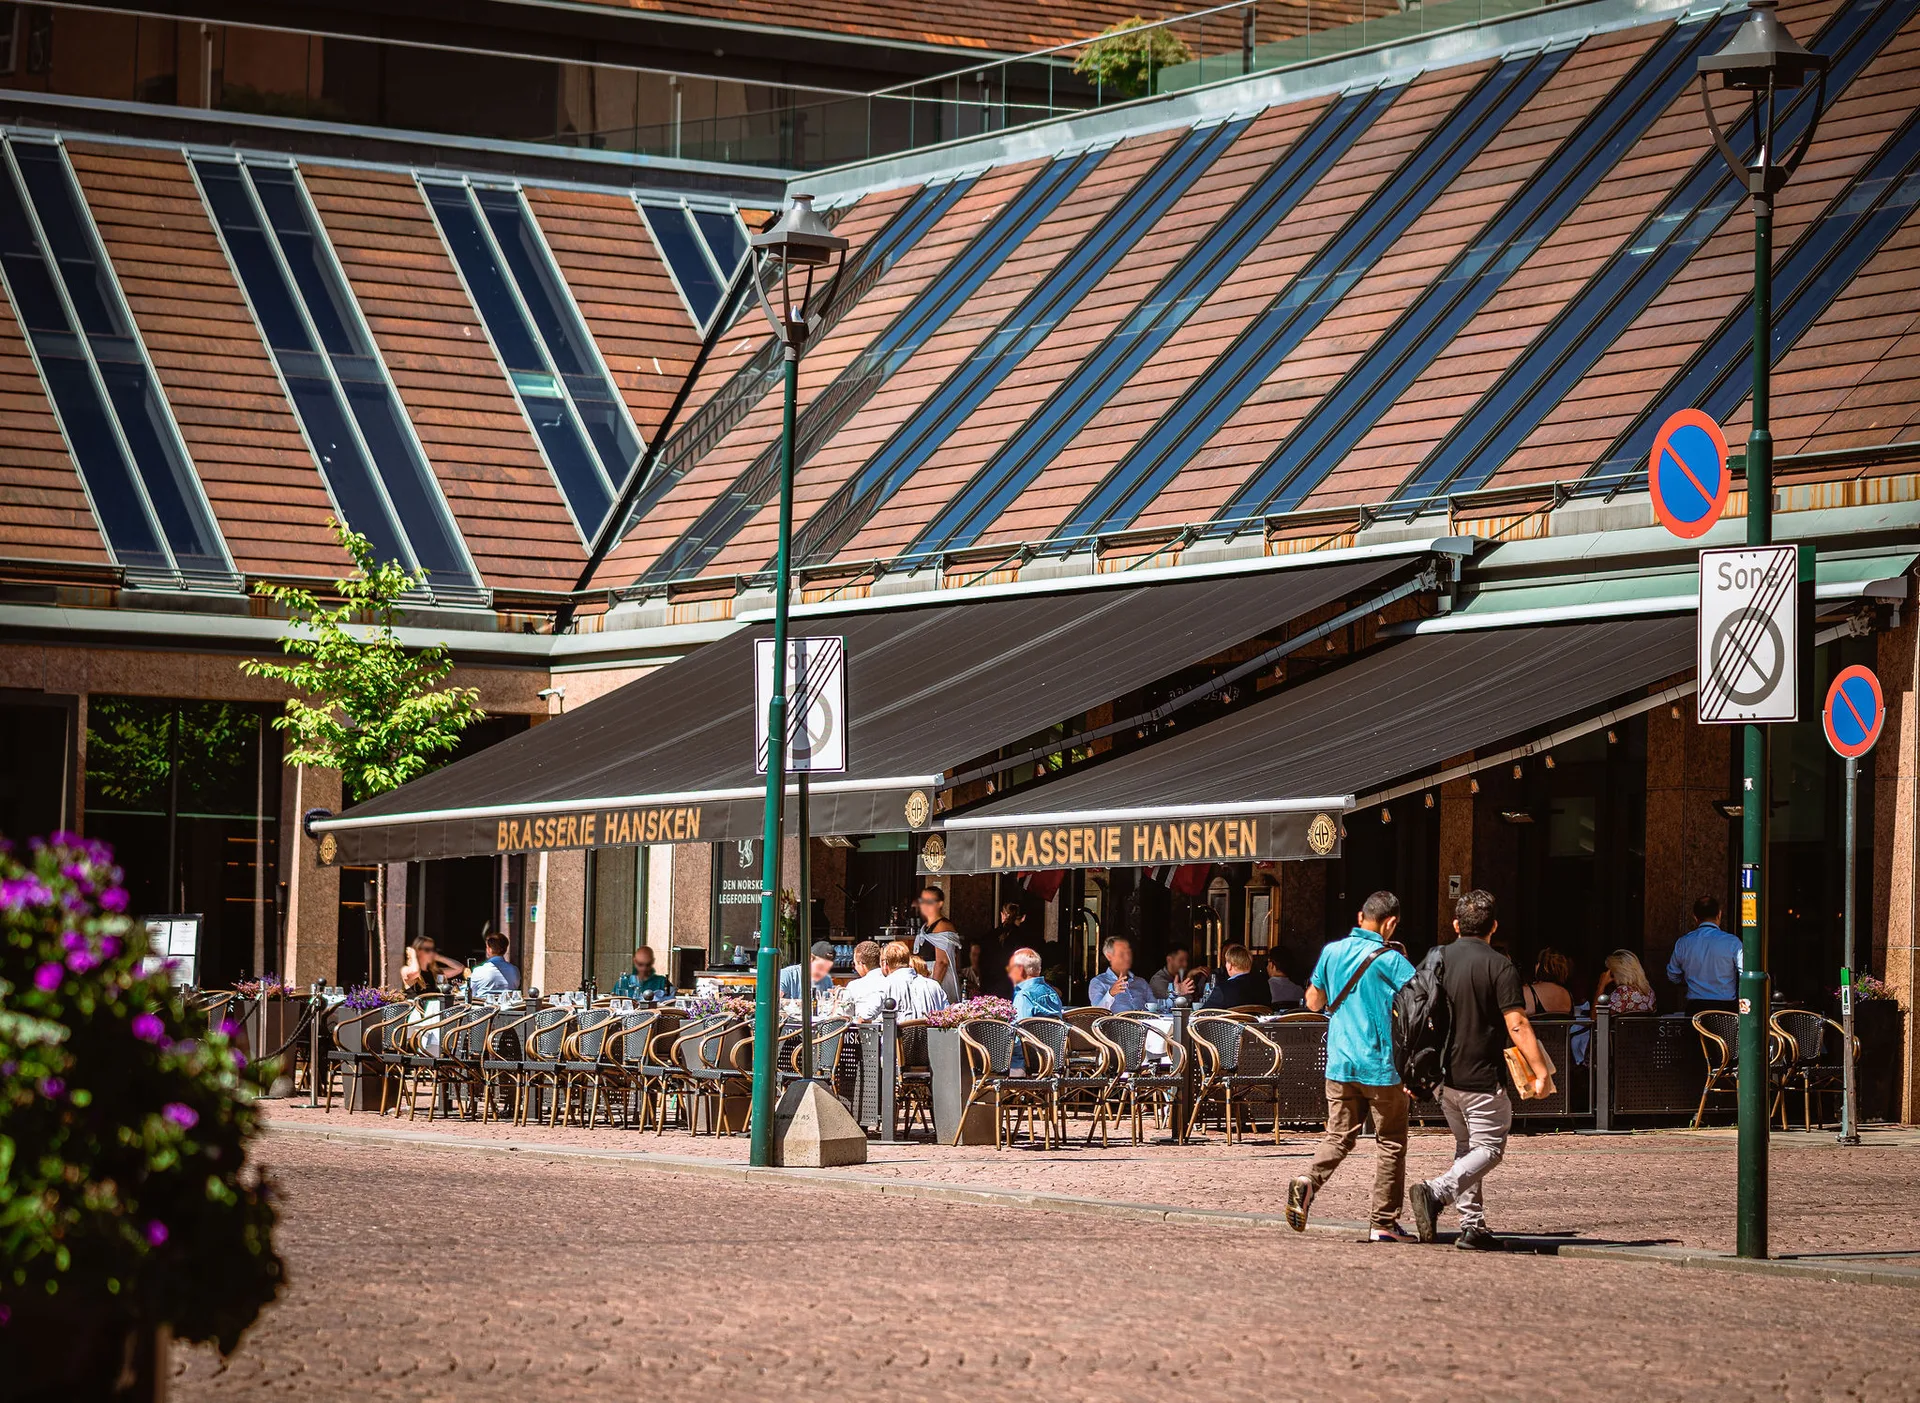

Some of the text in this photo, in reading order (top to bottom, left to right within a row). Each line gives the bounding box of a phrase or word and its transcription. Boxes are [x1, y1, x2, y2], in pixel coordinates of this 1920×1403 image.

[1717, 561, 1779, 591] Sone
[772, 650, 826, 670] one
[497, 807, 701, 850] BRASSERIE HANSKEN
[990, 819, 1258, 868] BRASSERIE HANSKEN
[723, 879, 763, 890] DEN NORSKE
[719, 893, 763, 904] LEGEFORENIN
